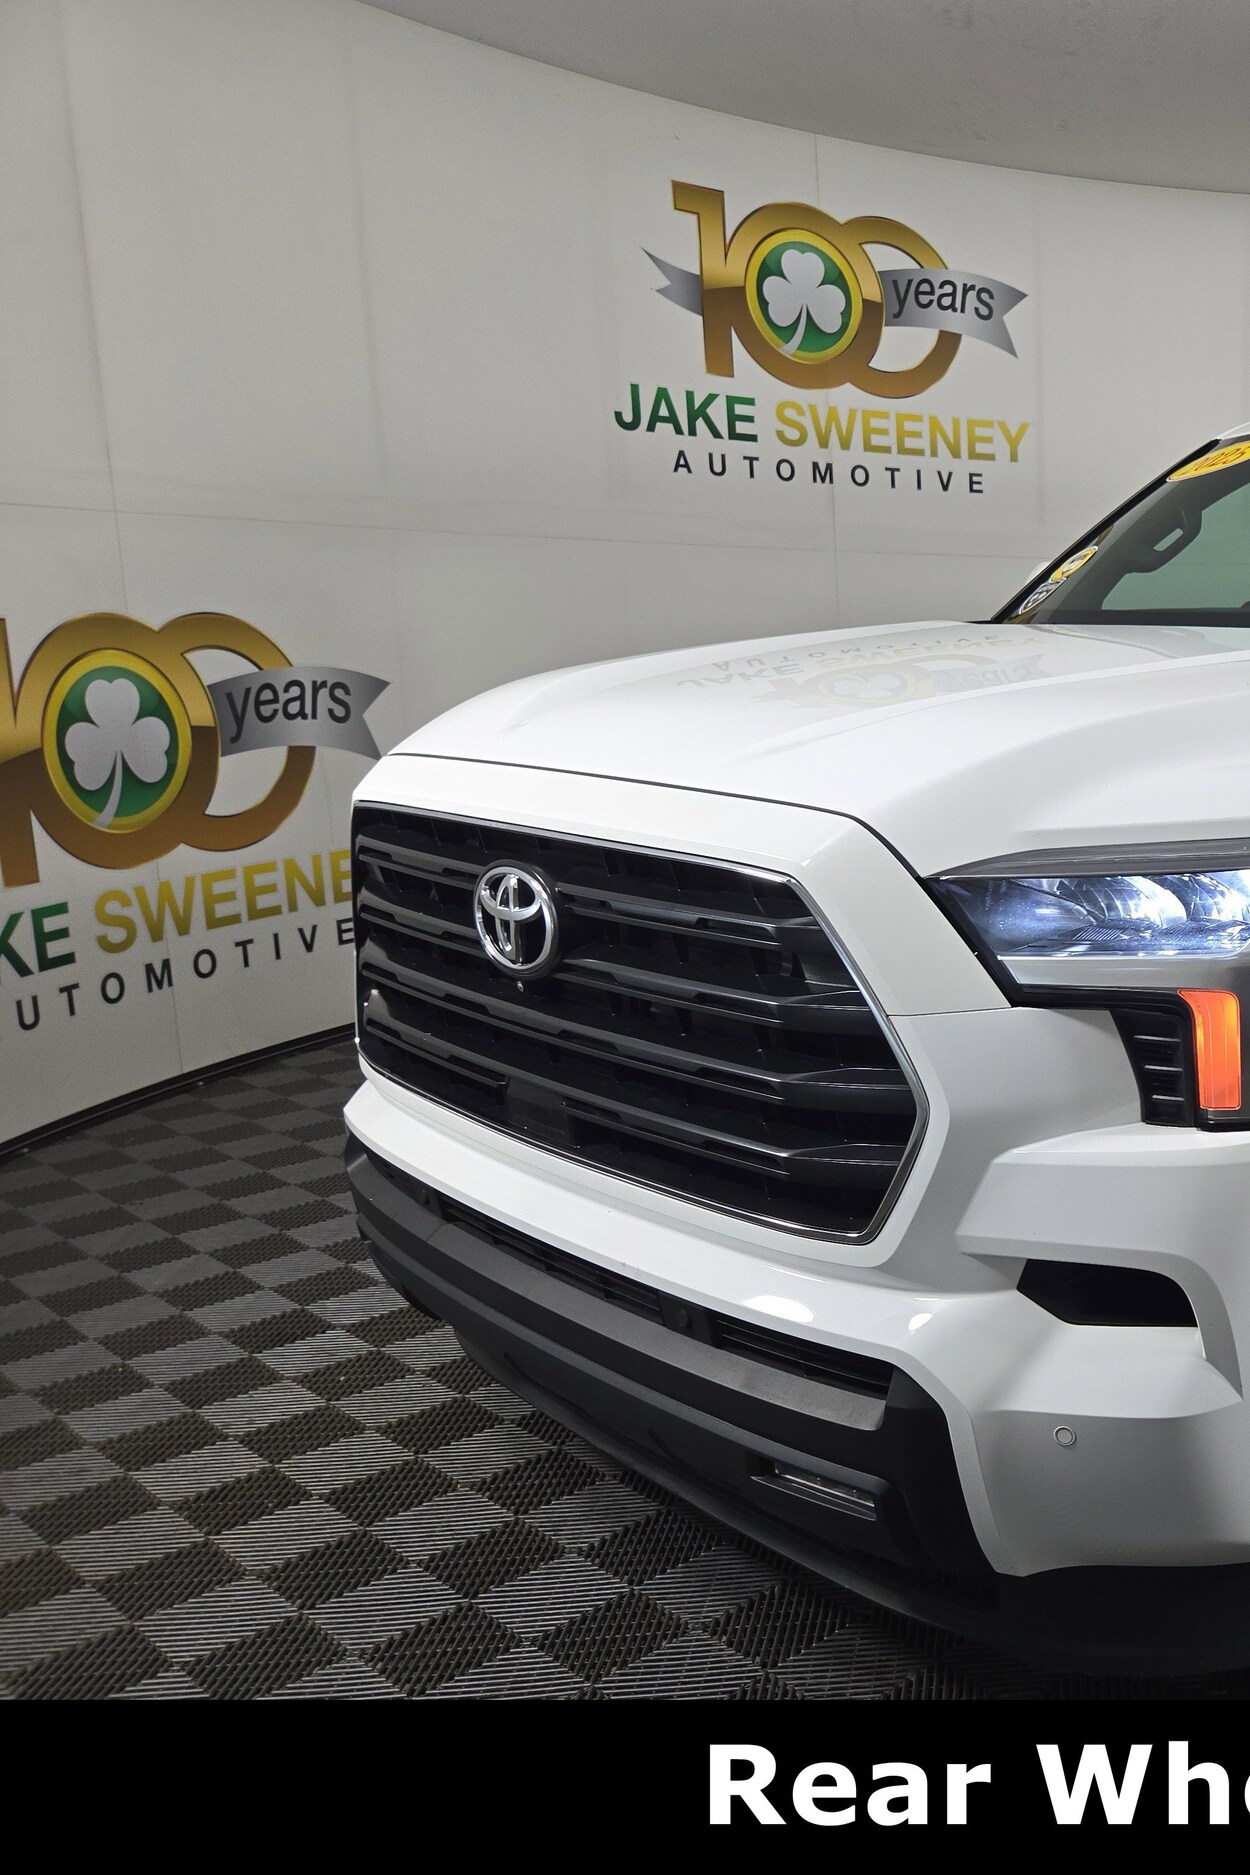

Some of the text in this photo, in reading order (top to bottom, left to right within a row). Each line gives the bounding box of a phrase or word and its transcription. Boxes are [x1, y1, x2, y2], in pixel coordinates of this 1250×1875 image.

[891, 276, 996, 323] years
[614, 383, 1031, 463] JAKE SWEENEY
[672, 450, 984, 494] AUTOMOTIVE
[225, 679, 353, 744] years
[0, 849, 352, 980] KE SWEENE
[16, 917, 355, 1031] UTOMOTIVE
